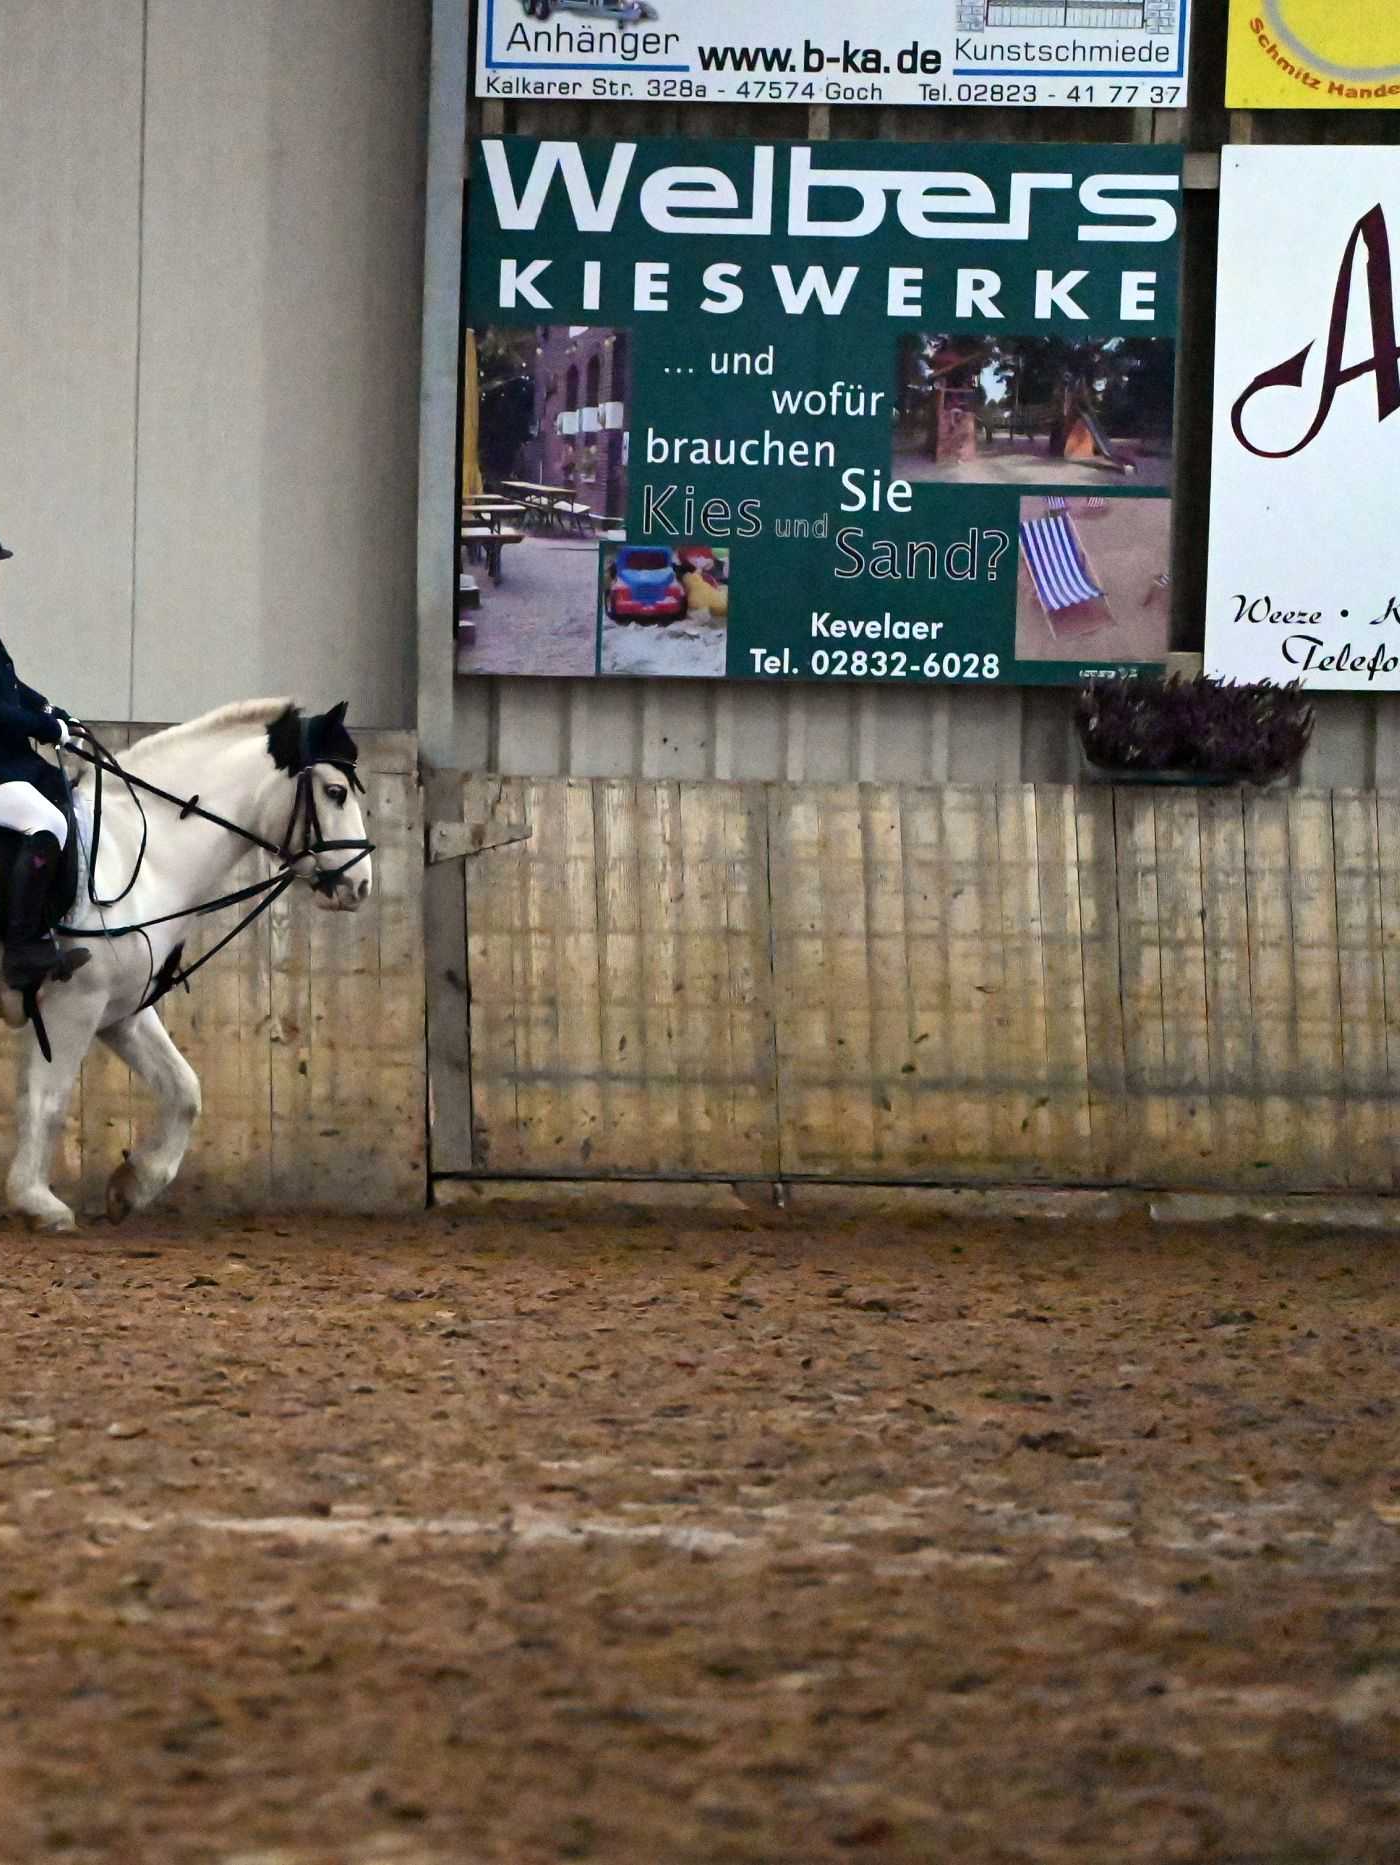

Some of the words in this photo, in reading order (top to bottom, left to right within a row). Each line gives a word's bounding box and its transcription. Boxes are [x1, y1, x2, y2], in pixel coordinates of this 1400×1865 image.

[506, 22, 680, 60] Anhänger
[698, 40, 942, 74] www.b-ka.de
[955, 38, 1170, 63] Kunstschmiede
[1249, 17, 1321, 90] Schmitz
[486, 76, 582, 96] Kalkarer
[592, 78, 633, 96] Str.
[647, 79, 707, 98] 328a
[736, 81, 815, 99] 47574
[825, 82, 882, 101] Goch
[1066, 85, 1094, 102] 41
[1108, 86, 1140, 103] 77
[1150, 86, 1181, 103] 37
[481, 139, 1181, 242] Welbers
[499, 258, 1157, 321] KIESWERKE
[710, 345, 774, 376] und
[772, 381, 885, 417] wofür
[646, 427, 836, 468] brauchen
[840, 468, 913, 513] Sie
[642, 485, 763, 538] Kies
[775, 513, 830, 540] und
[834, 527, 1010, 582] Sand?
[810, 612, 944, 641] Kevelaer
[1232, 594, 1323, 625] Weeze
[749, 648, 799, 675] Tel.
[810, 650, 1000, 680] 02832-6028
